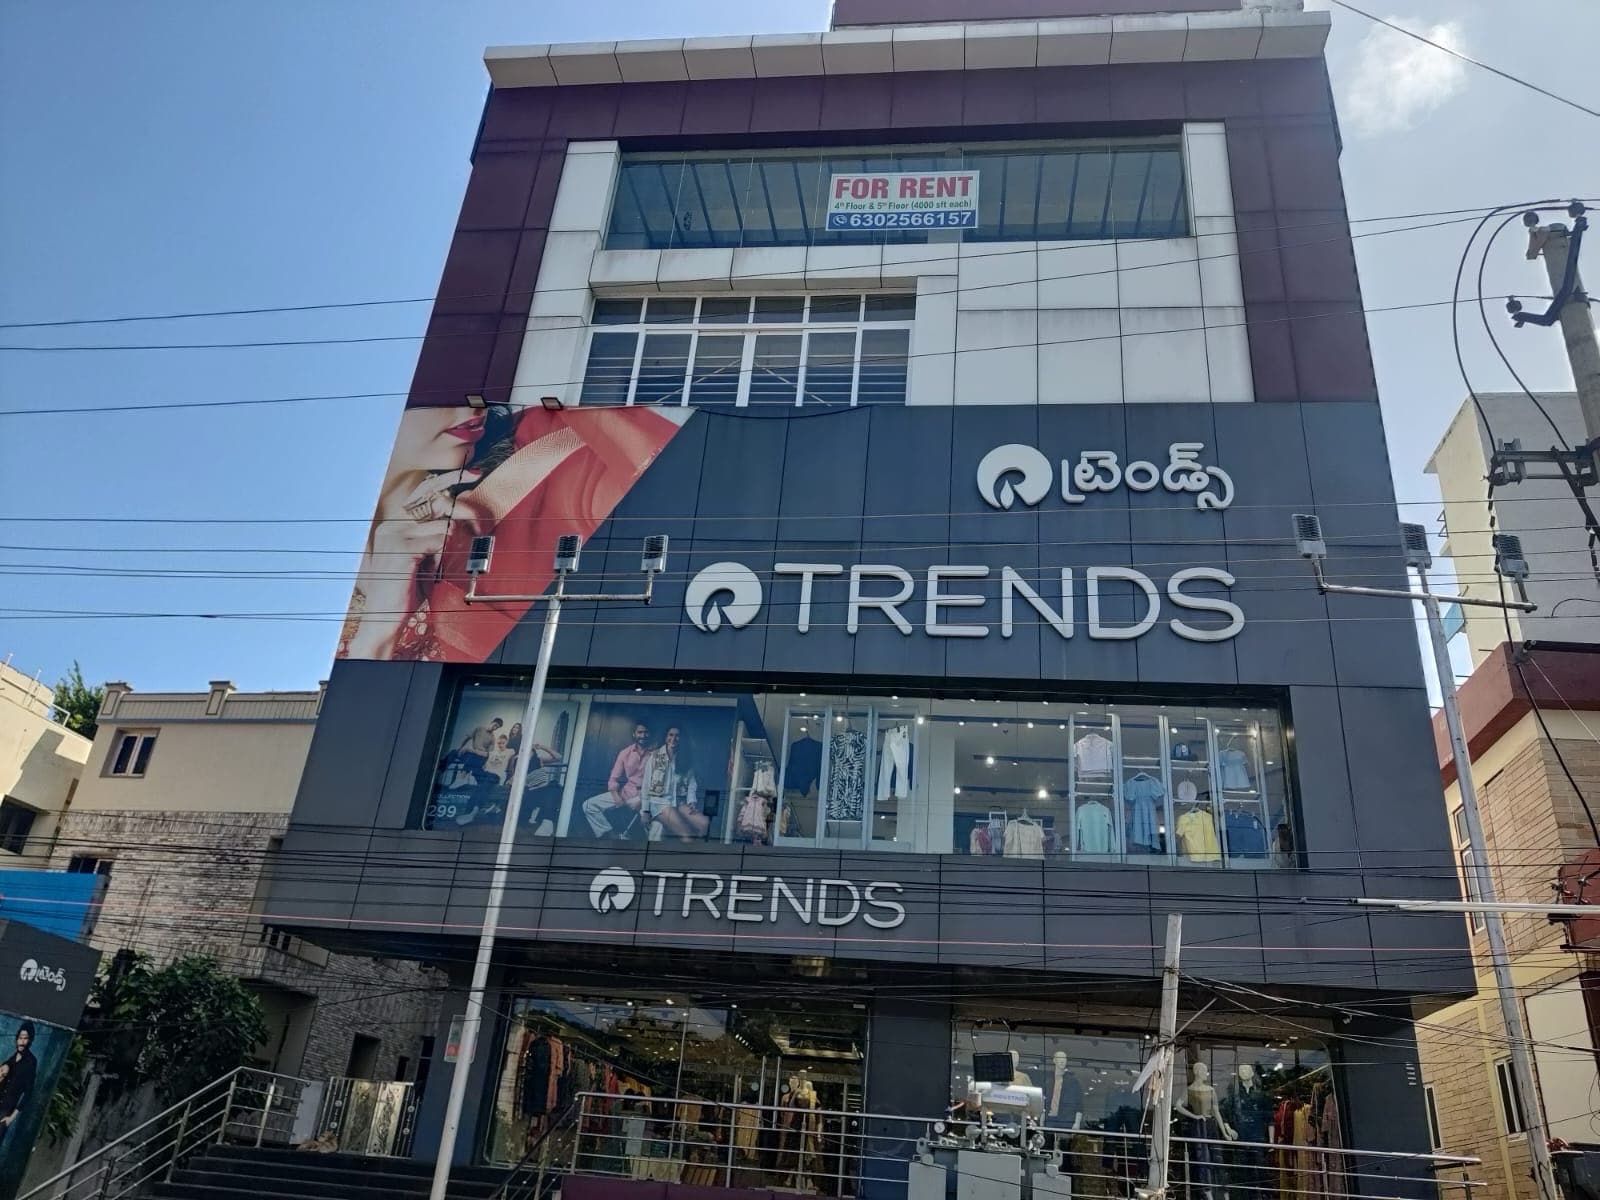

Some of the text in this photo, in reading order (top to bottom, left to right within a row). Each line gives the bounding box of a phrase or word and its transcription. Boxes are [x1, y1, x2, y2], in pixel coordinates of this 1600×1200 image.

[835, 176, 974, 199] FOR RENT
[845, 202, 866, 210] Floor
[868, 202, 875, 210] &
[888, 201, 909, 210] Floor
[911, 200, 934, 210] (4000
[949, 199, 972, 209] each)
[850, 211, 972, 227] 6302566157
[1061, 442, 1235, 511] ట్రెండ్స్
[774, 563, 1246, 642] TRENDS
[643, 871, 906, 929] TRENDS
